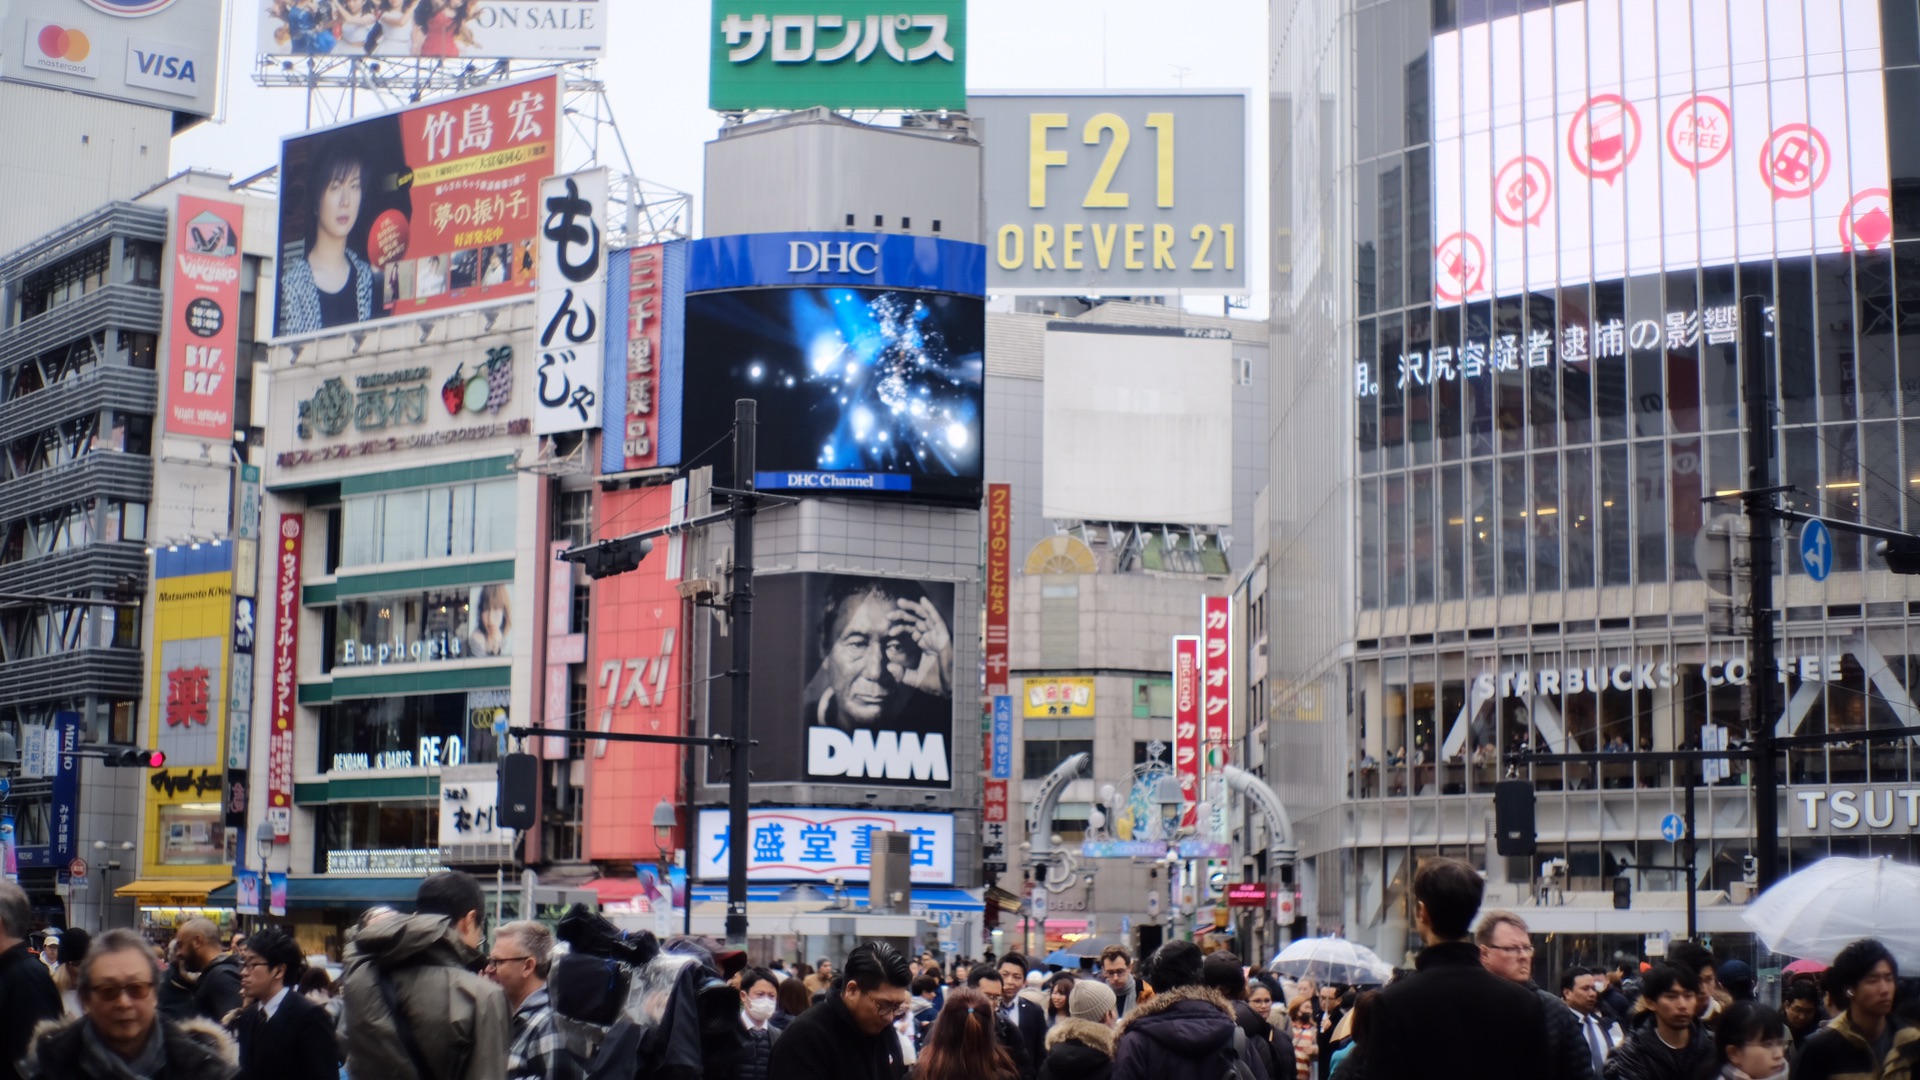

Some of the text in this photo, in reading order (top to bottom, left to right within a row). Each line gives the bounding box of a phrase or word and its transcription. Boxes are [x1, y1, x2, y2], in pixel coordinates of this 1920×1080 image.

[477, 6, 595, 30] ON SALE
[721, 14, 954, 63] サロンパス
[37, 58, 87, 73] mastercard
[133, 49, 196, 83] VISA
[421, 91, 544, 162] 竹島 宏
[1678, 131, 1721, 149] FREE
[1687, 114, 1719, 131] TAX
[1029, 112, 1175, 209] F21
[787, 241, 881, 275] DHC
[1190, 223, 1235, 270] 21
[537, 177, 600, 423] もんじゃ
[185, 344, 222, 369] B1F
[623, 251, 656, 458] 三千里薬品
[183, 370, 222, 396] B2F
[787, 473, 874, 488] DHC Channel
[991, 489, 1008, 615] クスリのことなら
[342, 631, 461, 667] Euphoria
[1206, 610, 1228, 716] カラオケ
[167, 664, 210, 729] 薬
[1478, 655, 1844, 700] STARBUCKS COFEE
[385, 750, 412, 770] DARTS
[420, 734, 462, 768] RE/D
[808, 725, 950, 782] DMM
[58, 804, 69, 855] みずほ銀行
[1797, 789, 1920, 830] TSUT
[1048, 900, 1086, 911] DEMO
